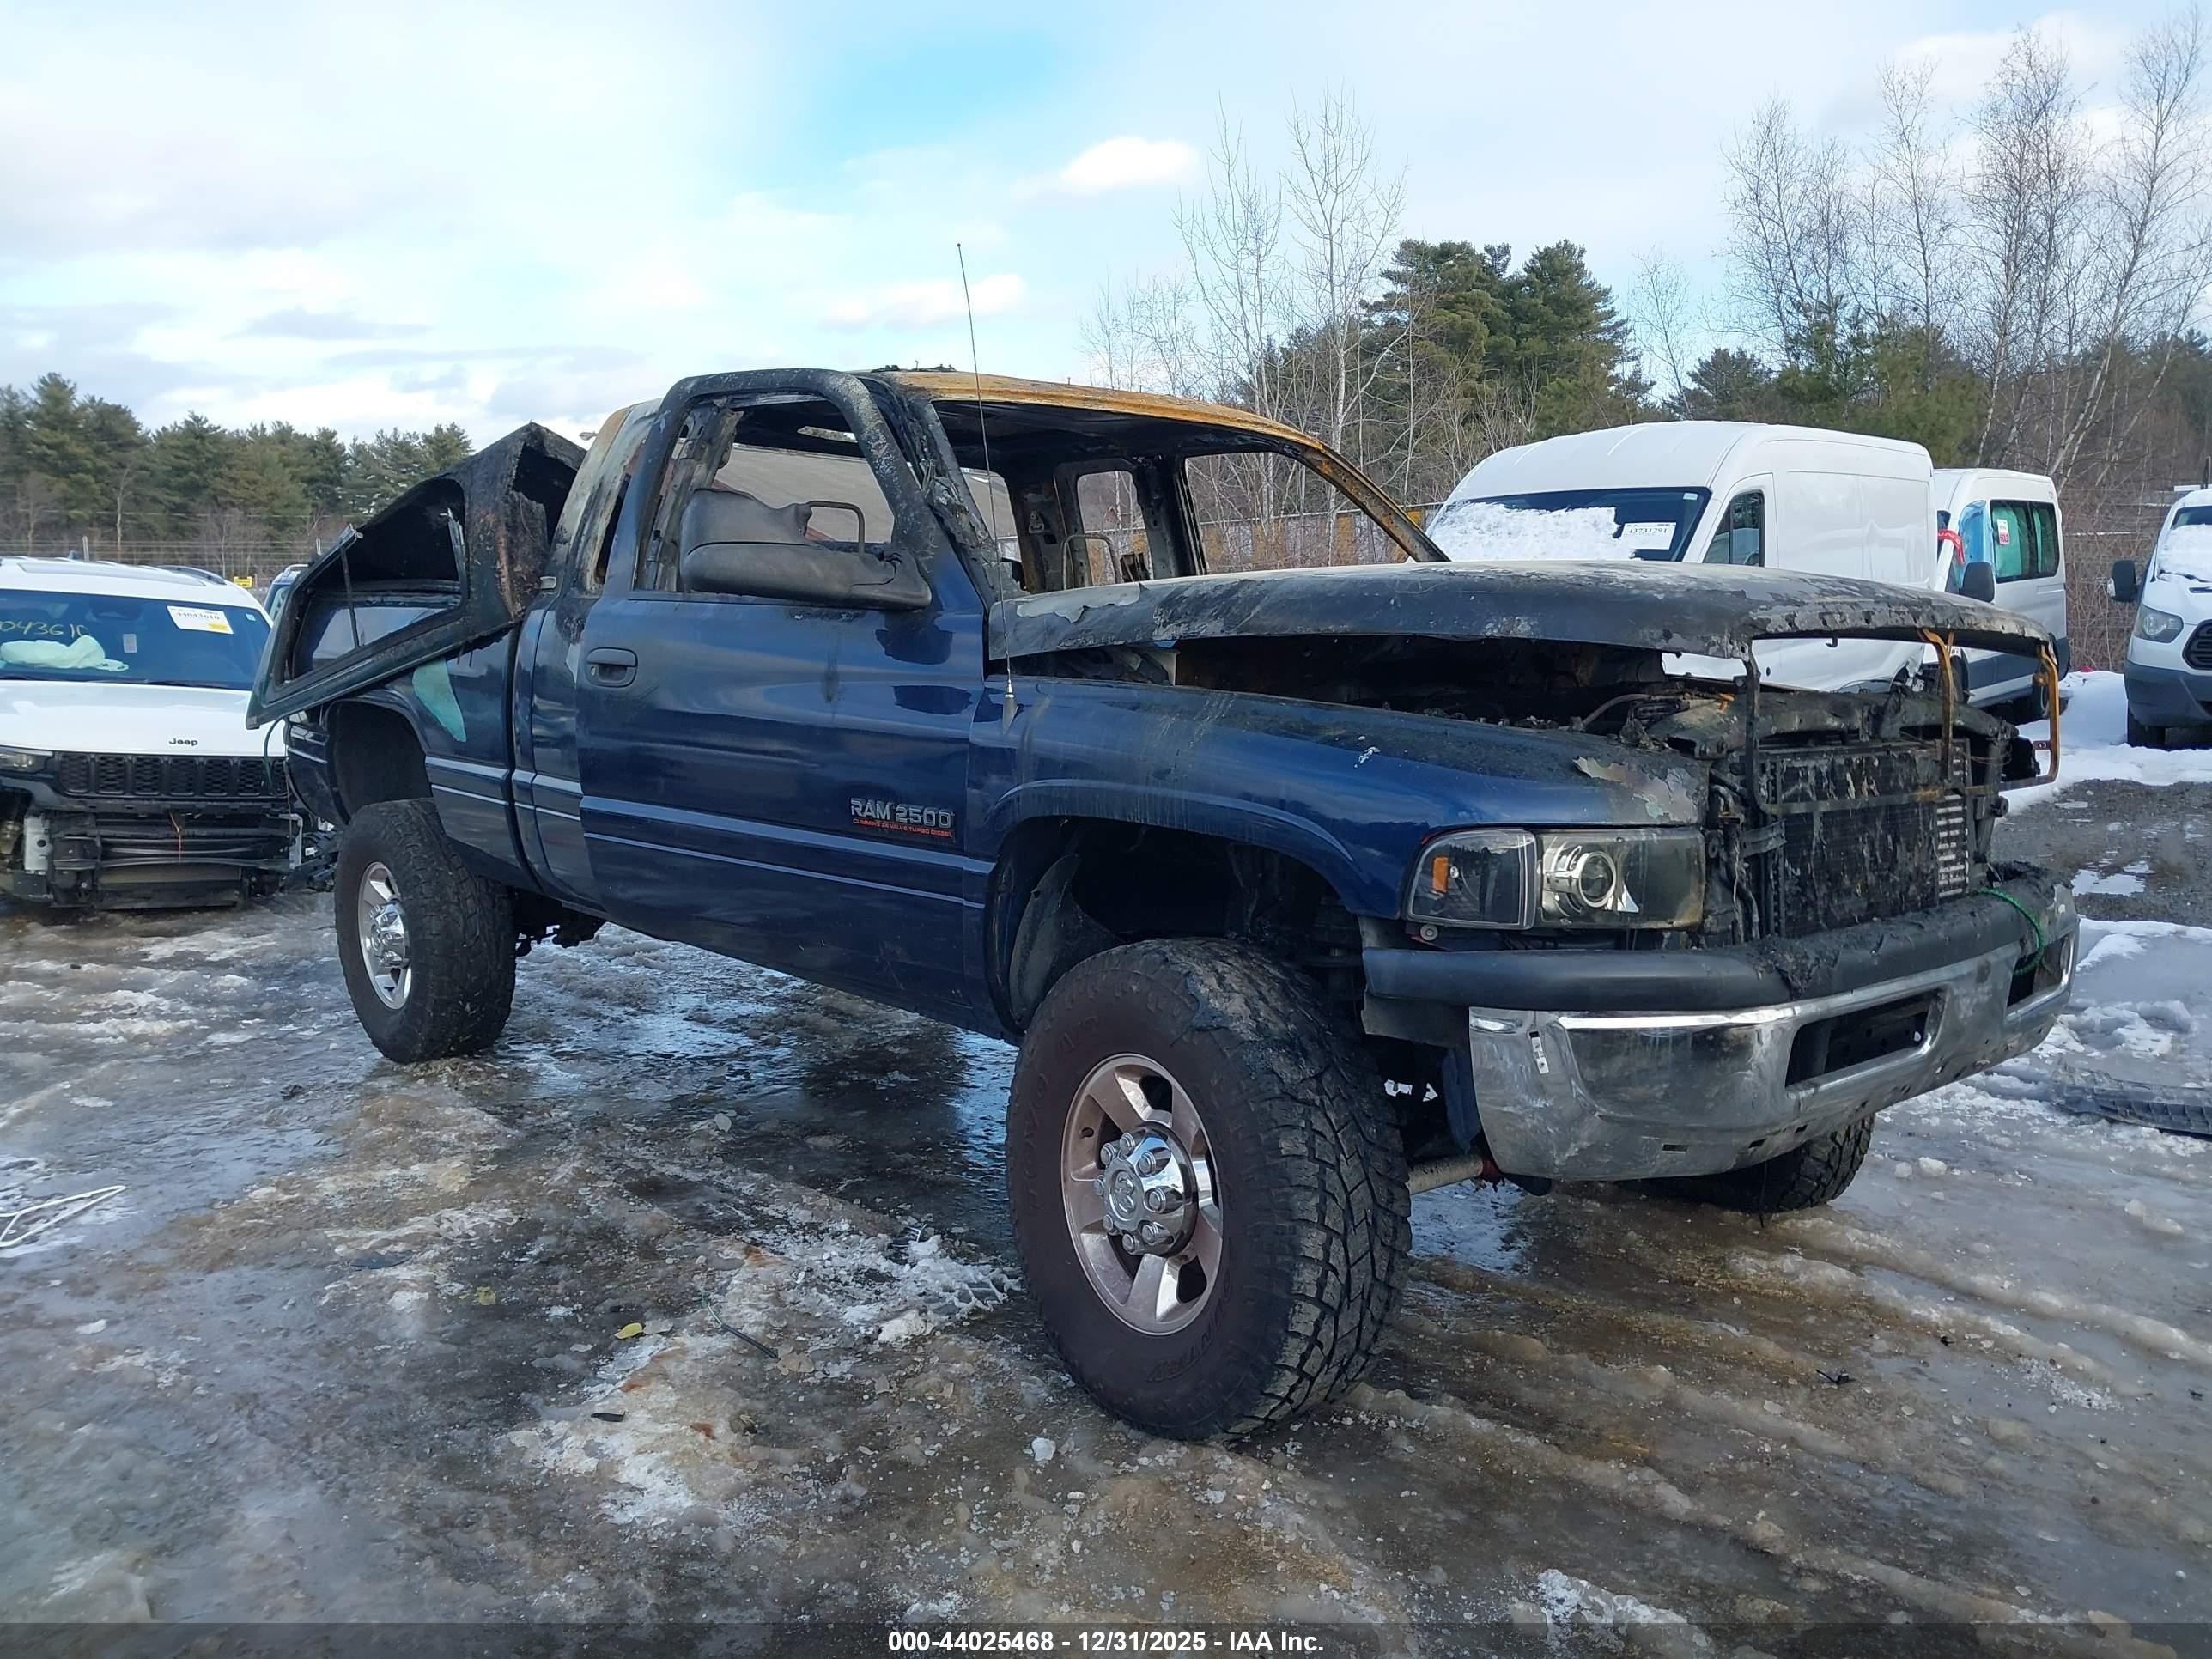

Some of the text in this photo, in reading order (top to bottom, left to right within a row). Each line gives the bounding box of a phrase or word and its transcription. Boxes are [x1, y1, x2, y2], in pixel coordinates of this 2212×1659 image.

[168, 738, 198, 746] Jeep
[850, 797, 951, 829] RAM 2500
[908, 826, 930, 835] TURBO
